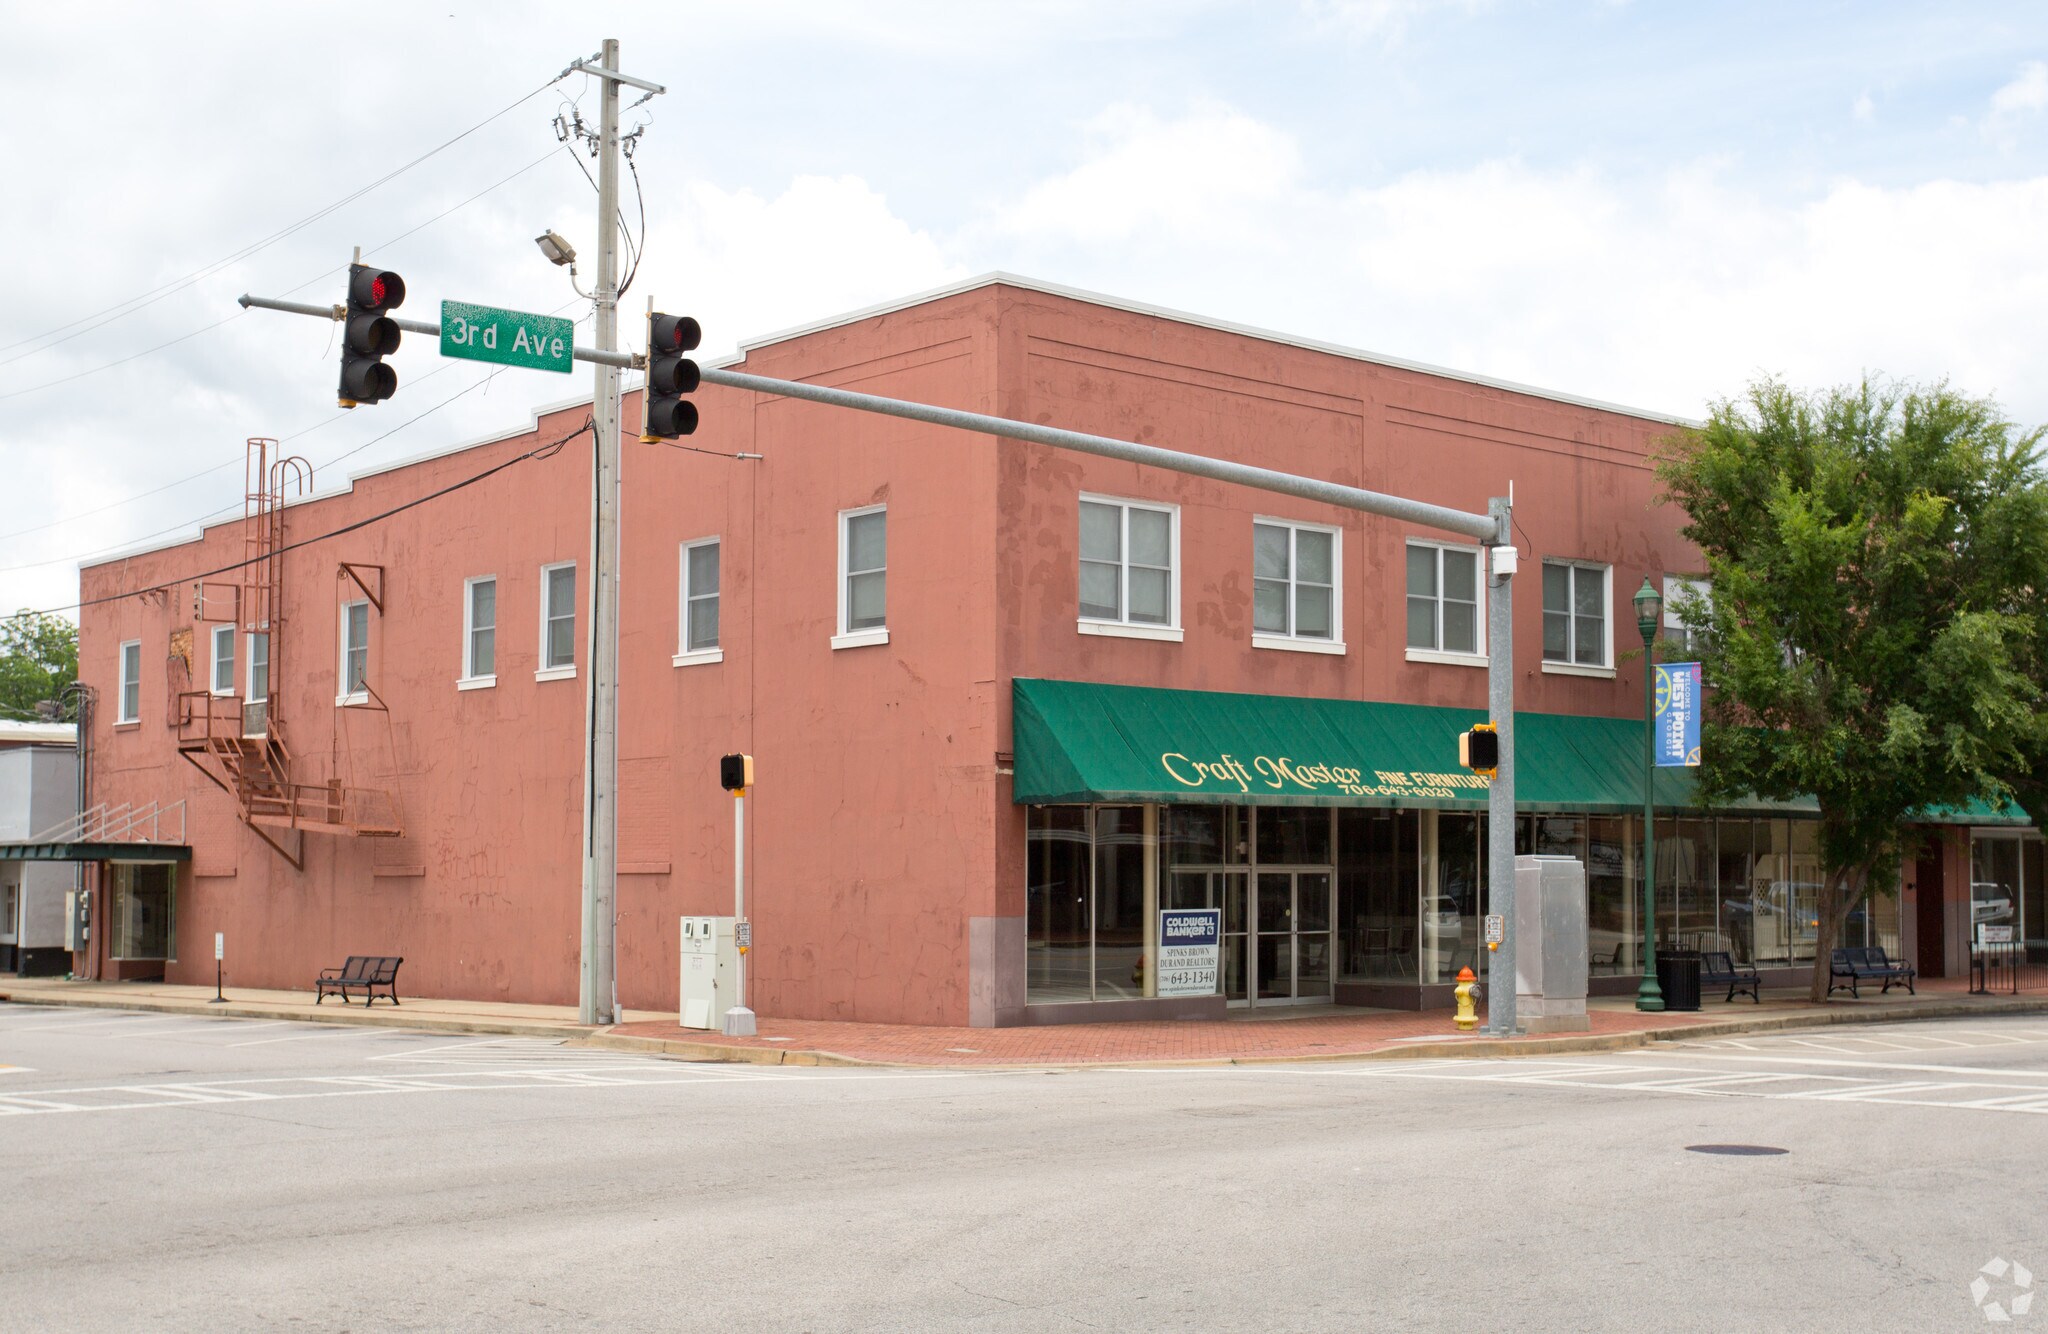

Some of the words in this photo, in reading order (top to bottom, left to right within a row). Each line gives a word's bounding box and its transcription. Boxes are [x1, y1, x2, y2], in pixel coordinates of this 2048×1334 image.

[451, 317, 498, 349] 3rd
[511, 326, 565, 359] Ave
[1672, 671, 1685, 710] WEST
[1685, 711, 1691, 721] TO
[1672, 711, 1685, 759] POINT
[1161, 752, 1253, 793] Craft
[1253, 755, 1361, 790] Master
[1374, 770, 1414, 786] FINE
[1167, 948, 1187, 957] SPINKS
[1188, 947, 1210, 956] BROWN
[1160, 959, 1185, 968] DURAND
[1171, 971, 1215, 985] 643-1340
